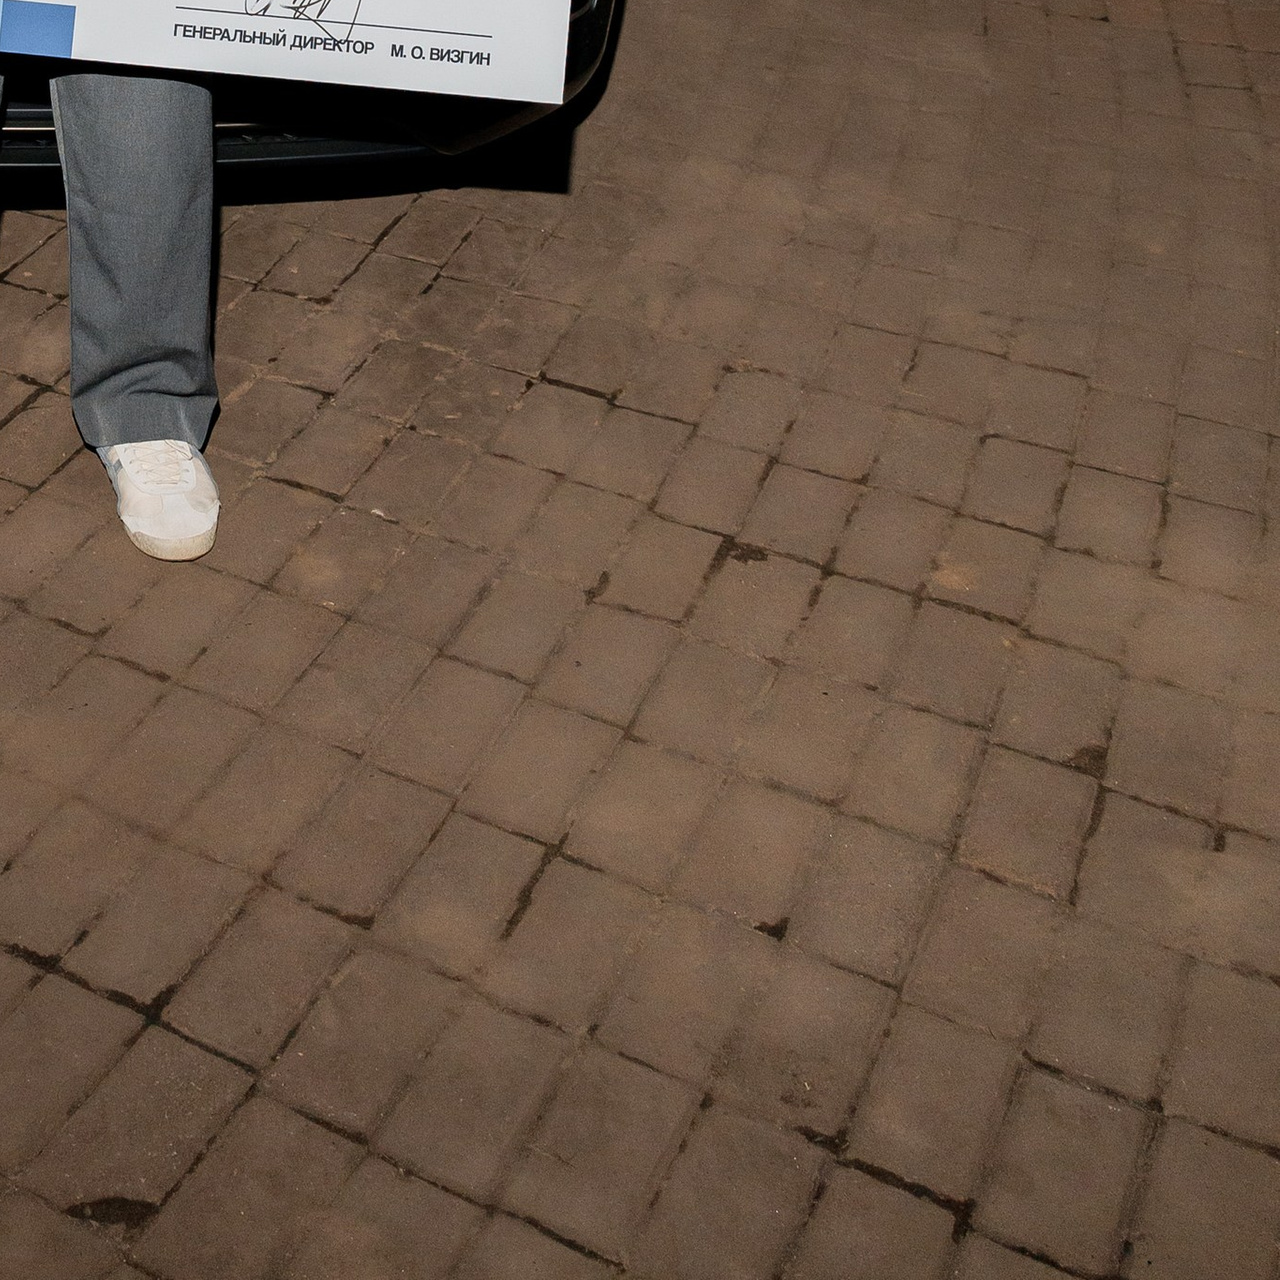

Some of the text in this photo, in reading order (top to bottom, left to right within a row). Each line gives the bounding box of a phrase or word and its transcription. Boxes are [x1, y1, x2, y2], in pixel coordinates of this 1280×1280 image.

[173, 23, 492, 67] ГЕНЕРАЛЬНЫЙ ДИРЕКТОР М. О. ВИЗГИН
